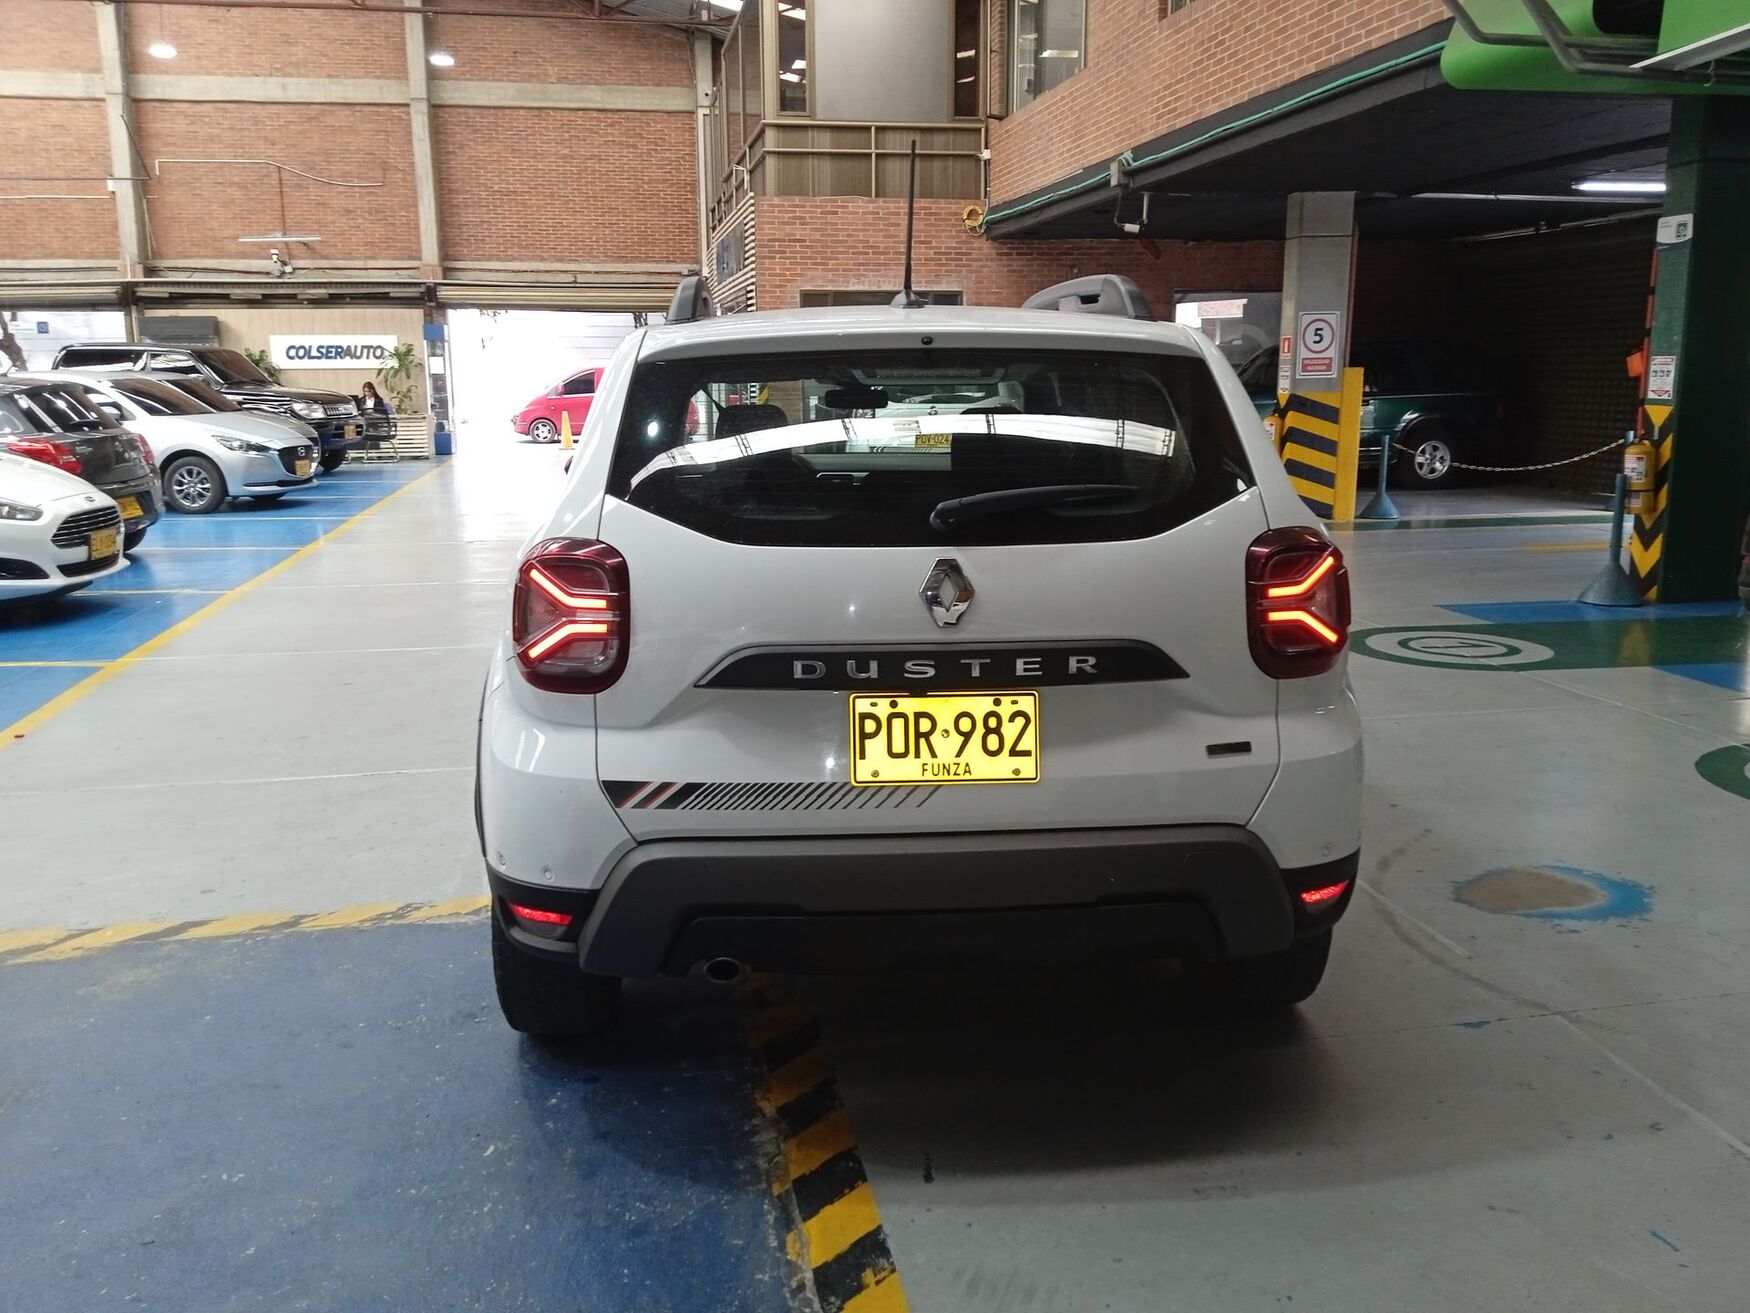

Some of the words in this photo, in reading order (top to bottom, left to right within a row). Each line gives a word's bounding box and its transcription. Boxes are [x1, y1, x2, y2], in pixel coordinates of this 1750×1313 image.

[1313, 327, 1324, 344] 5
[285, 344, 385, 361] COLSERAUTO
[793, 655, 1098, 679] DUSTER
[921, 762, 973, 777] FUNZA
